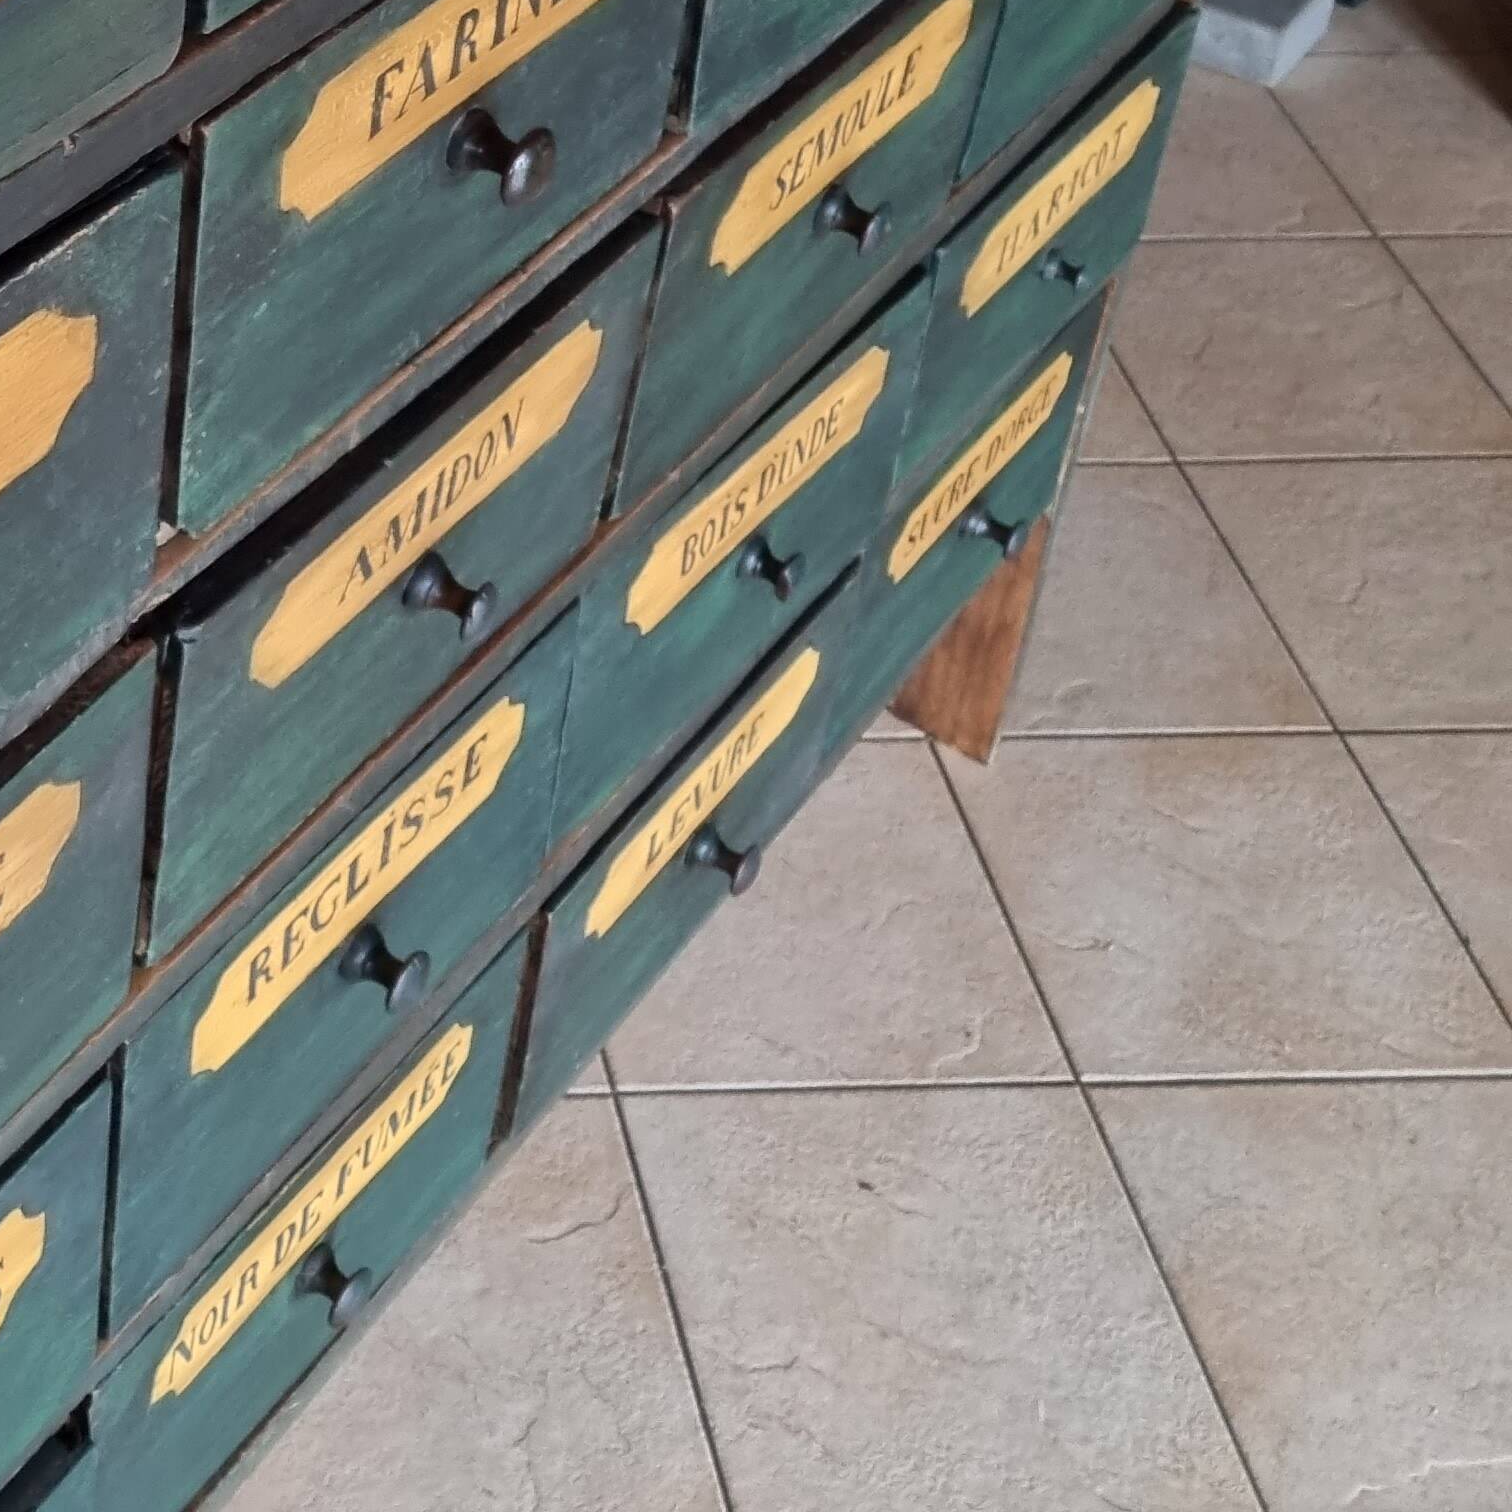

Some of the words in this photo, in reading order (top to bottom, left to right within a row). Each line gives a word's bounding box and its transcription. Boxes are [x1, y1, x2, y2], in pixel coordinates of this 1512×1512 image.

[769, 44, 923, 211] SEMOULE
[997, 120, 1128, 273] HARICOT
[338, 396, 525, 606] AMIDON
[681, 486, 750, 577] BOIS
[646, 711, 766, 870] LEVURE
[168, 1260, 260, 1385] NOIR
[271, 1189, 326, 1271] DE
